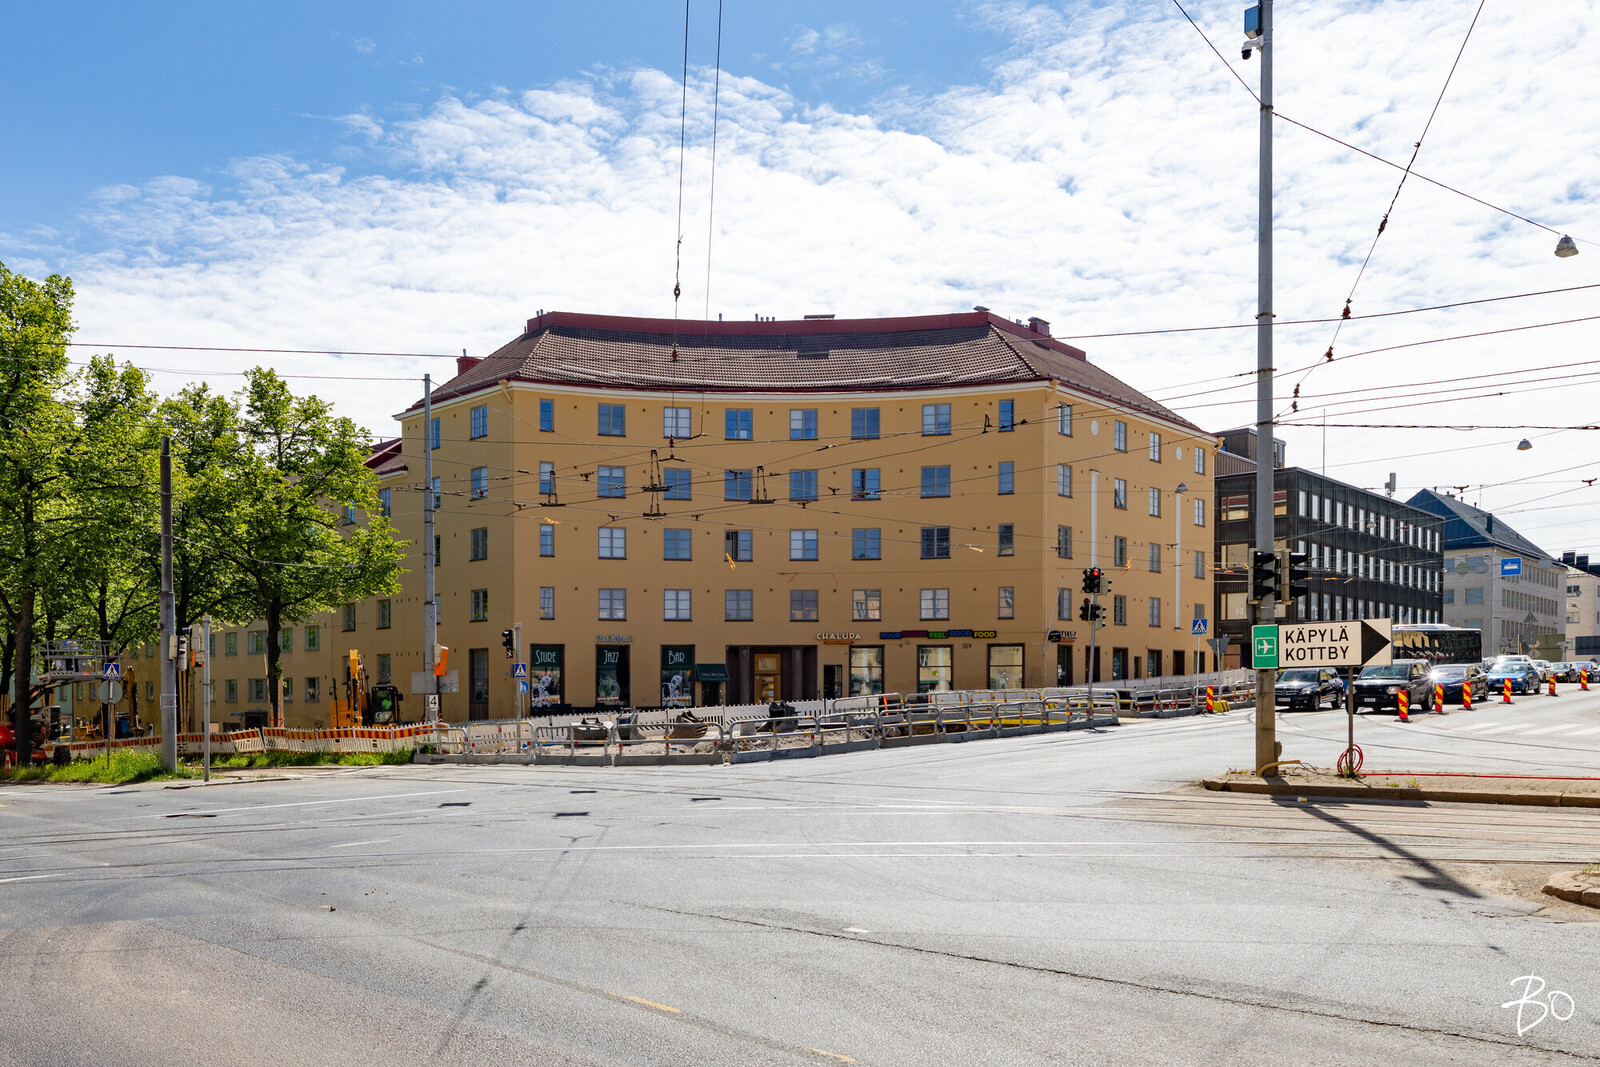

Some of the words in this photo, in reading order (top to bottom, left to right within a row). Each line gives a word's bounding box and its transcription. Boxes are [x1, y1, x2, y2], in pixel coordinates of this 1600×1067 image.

[816, 632, 861, 640] CHALUPA
[1285, 625, 1349, 644] KÄPYLÄ
[535, 650, 556, 664] STURE
[603, 650, 619, 664] JAZZ
[668, 650, 685, 664] BAR
[1285, 645, 1349, 661] KOTTBY
[430, 695, 437, 706] 4
